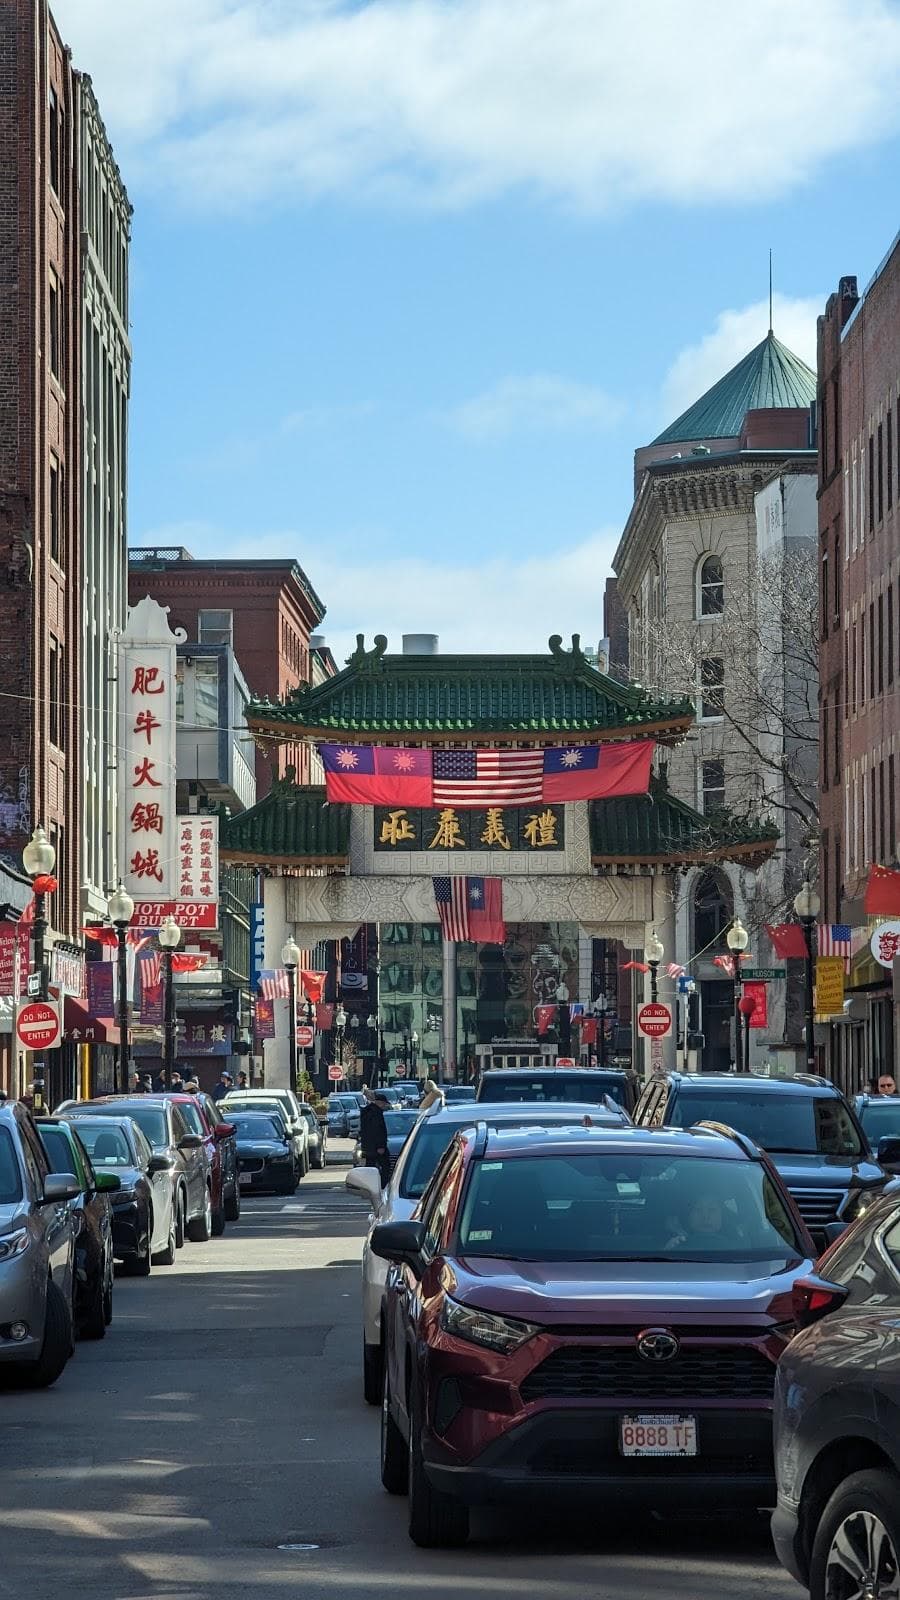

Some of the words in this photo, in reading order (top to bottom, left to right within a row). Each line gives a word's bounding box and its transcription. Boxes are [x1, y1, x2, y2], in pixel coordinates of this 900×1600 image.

[131, 666, 164, 883] 肥牛火鍋城
[174, 903, 209, 916] POT
[138, 915, 199, 927] BUFET
[23, 1014, 33, 1022] DO
[38, 1011, 51, 1020] NOT
[27, 1031, 51, 1041] ENTER
[624, 1426, 668, 1447] 8888
[673, 1426, 694, 1447] TF
